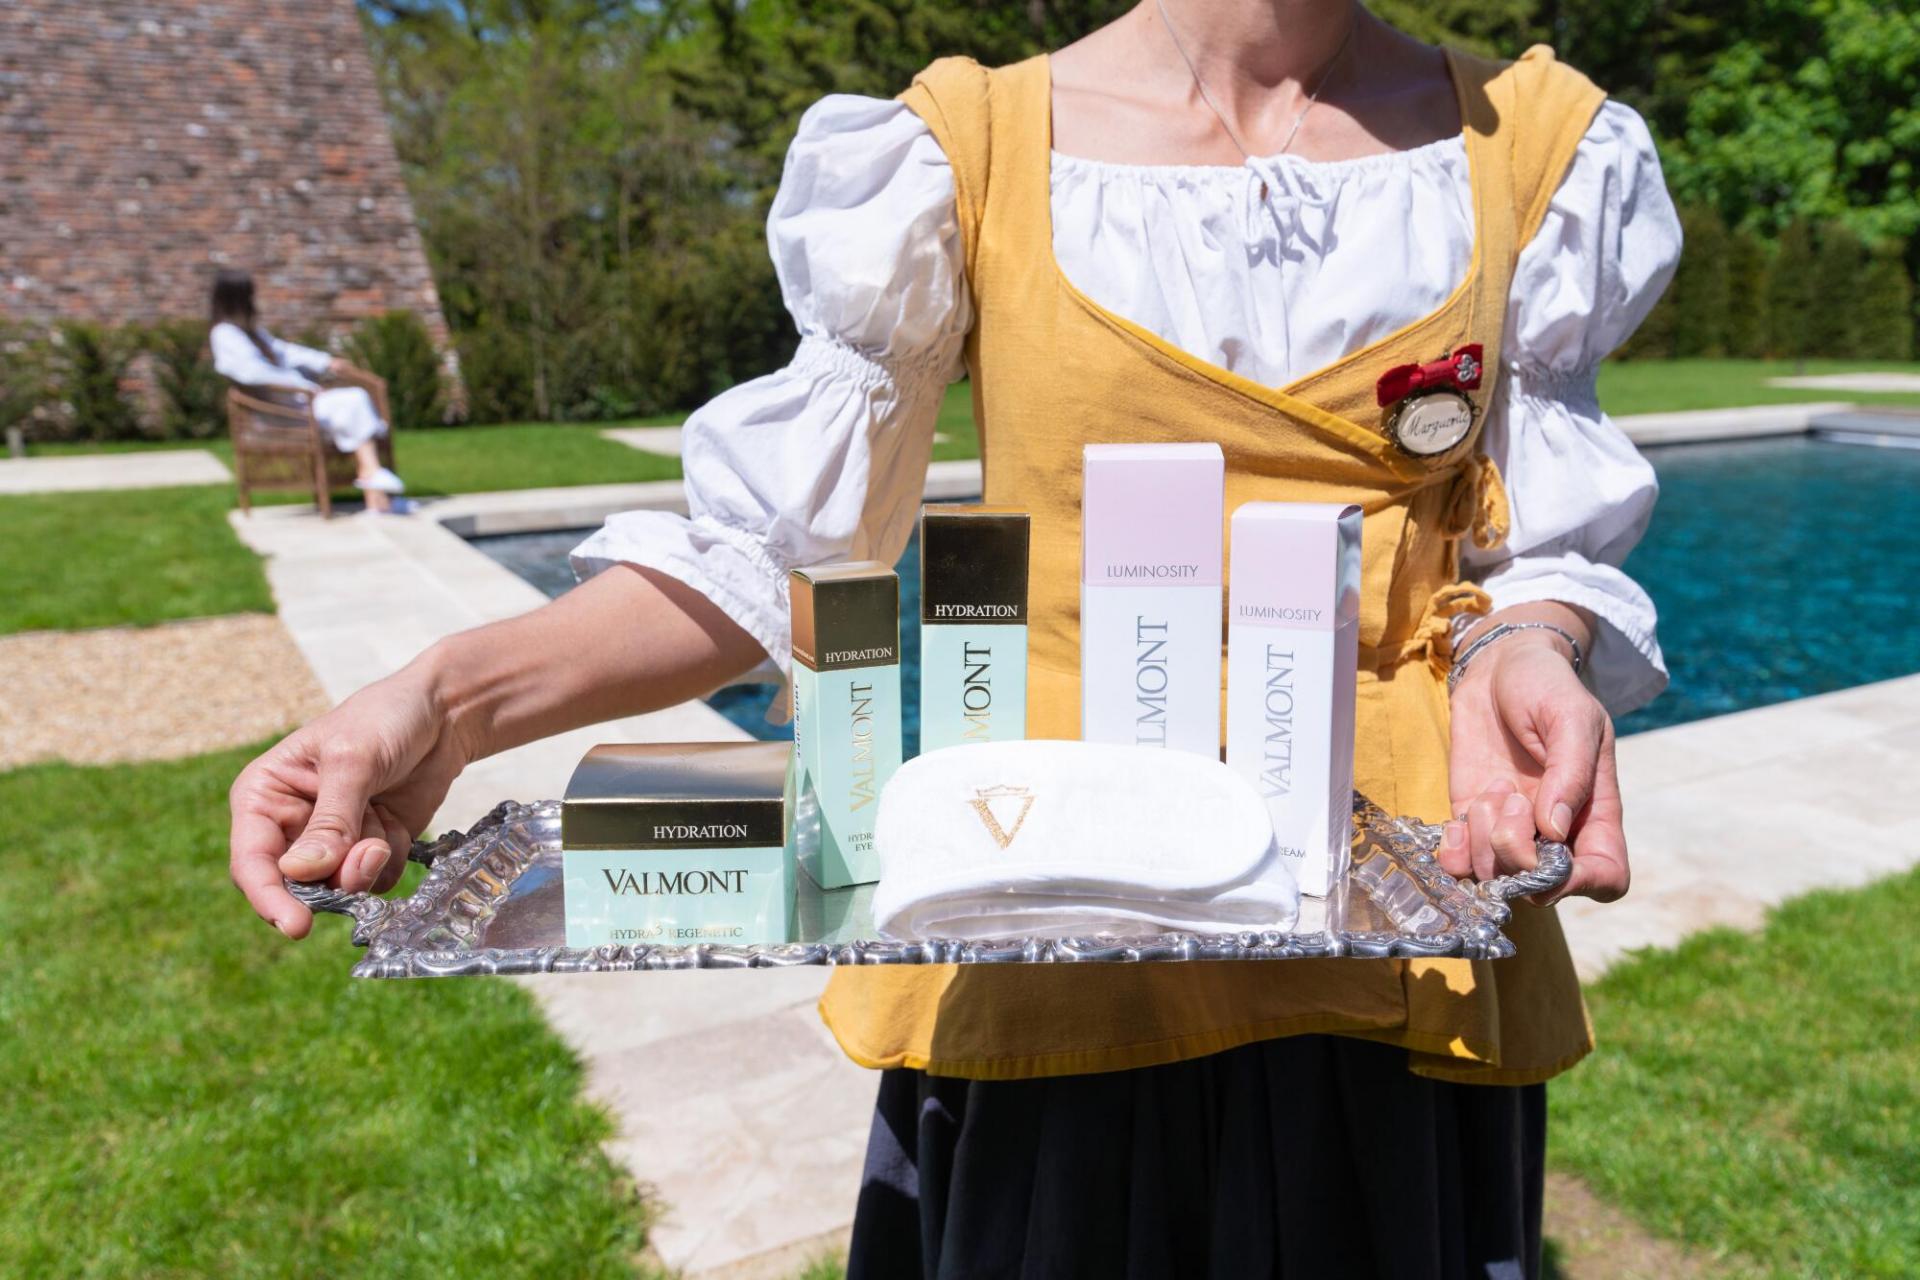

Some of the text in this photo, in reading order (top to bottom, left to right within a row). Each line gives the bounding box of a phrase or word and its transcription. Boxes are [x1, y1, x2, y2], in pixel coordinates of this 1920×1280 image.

[1106, 564, 1200, 579] LUMINOSITY
[935, 604, 1018, 618] HYDRATION
[1239, 604, 1322, 623] LUMINOSITY
[825, 647, 893, 663] HYDRATION
[1136, 615, 1168, 748] LMONT
[963, 641, 991, 743] MONT
[1259, 643, 1294, 799] VALMONT
[849, 681, 875, 813] VALMONT
[653, 824, 748, 839] HYDRATION
[848, 832, 874, 843] HYDR
[602, 869, 749, 896] VALMONT
[668, 926, 743, 940] REGENETIC
